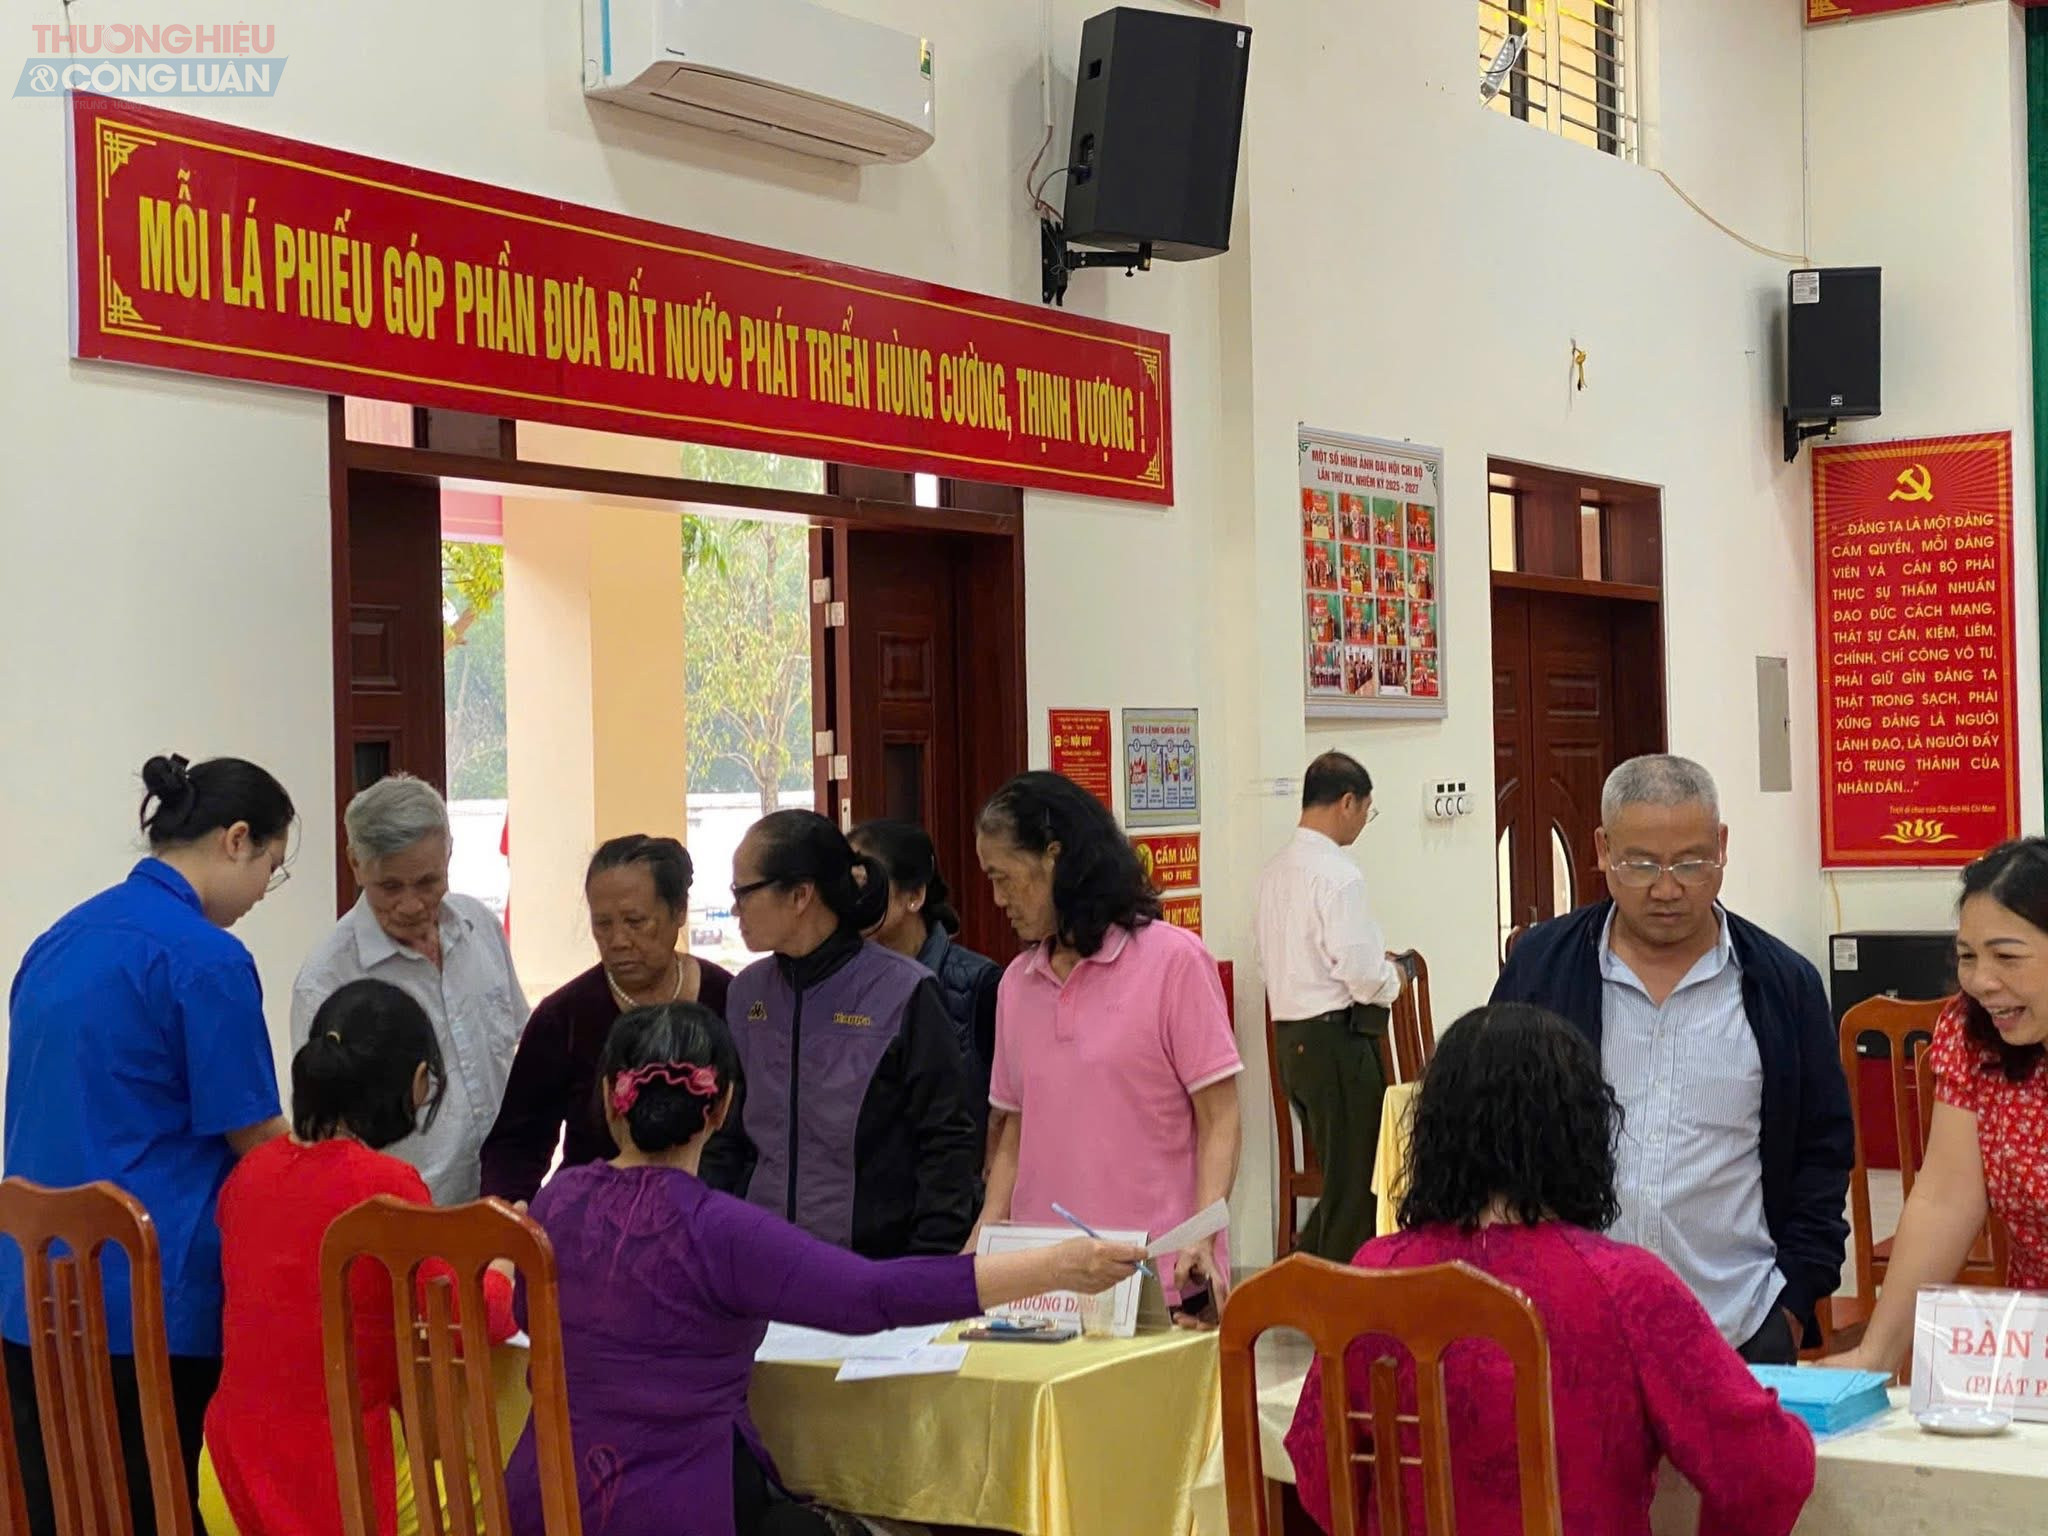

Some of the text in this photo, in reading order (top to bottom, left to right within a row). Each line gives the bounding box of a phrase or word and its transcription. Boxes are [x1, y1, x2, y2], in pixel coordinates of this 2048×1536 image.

[139, 168, 1146, 462] MỖI LÁ PHIẾU GÓP PHẦN ĐƯA ĐẤT NƯỚC PHÁT TRIỂN HÙNG CƯỜNG, THỊNH VƯỢNG !
[1312, 449, 1327, 465] MỘT
[1329, 450, 1339, 465] SỐ
[1359, 454, 1373, 470] ẢNH
[1389, 461, 1400, 476] HỘI
[1401, 464, 1412, 477] CHI
[1414, 464, 1423, 480] BỘ
[1385, 480, 1400, 491] 2025
[1888, 520, 1903, 533] TA
[1906, 515, 1921, 531] LÀ
[1924, 514, 1951, 532] MỘT
[1954, 511, 1994, 528] ĐẢNG
[1922, 533, 1948, 551] MỖI
[1955, 533, 1995, 550] ĐẢNG
[1832, 553, 1995, 579] VIÊN VÀ CÁN BỘ PHẢI
[1832, 588, 1865, 603] THỰC
[1876, 586, 1891, 601] SỰ
[1901, 580, 1937, 597] THẤM
[1833, 602, 1996, 624] ĐẠO ĐỨC CÁCH MẠNG,
[1833, 628, 1862, 646] THẬT
[1867, 628, 1882, 645] SỰ
[1925, 624, 1959, 641] KIỆM,
[1881, 648, 1904, 663] CHÍ
[1908, 646, 1949, 662] CÔNG
[1954, 644, 1974, 660] VÔ
[1835, 666, 1998, 687] PHẢI GIỮ GÌN ĐẢNG TA
[1835, 687, 1998, 711] THẬT TRONG SẠCH, PHẢI
[1836, 714, 1872, 730] XỨNG
[1930, 711, 1946, 727] LÀ
[1955, 709, 1999, 726] NGƯỜI
[1836, 730, 1999, 752] LÃNH ĐẠO, LÀ NGƯỜI ĐẦY
[1836, 753, 2000, 773] TỚ TRUNG THÀNH CỦA
[1837, 779, 1873, 795] NHÂN
[1155, 843, 1197, 864] CẤM LỬA
[1162, 870, 1192, 881] NO FIRE
[1948, 1320, 2033, 1358] BÀN
